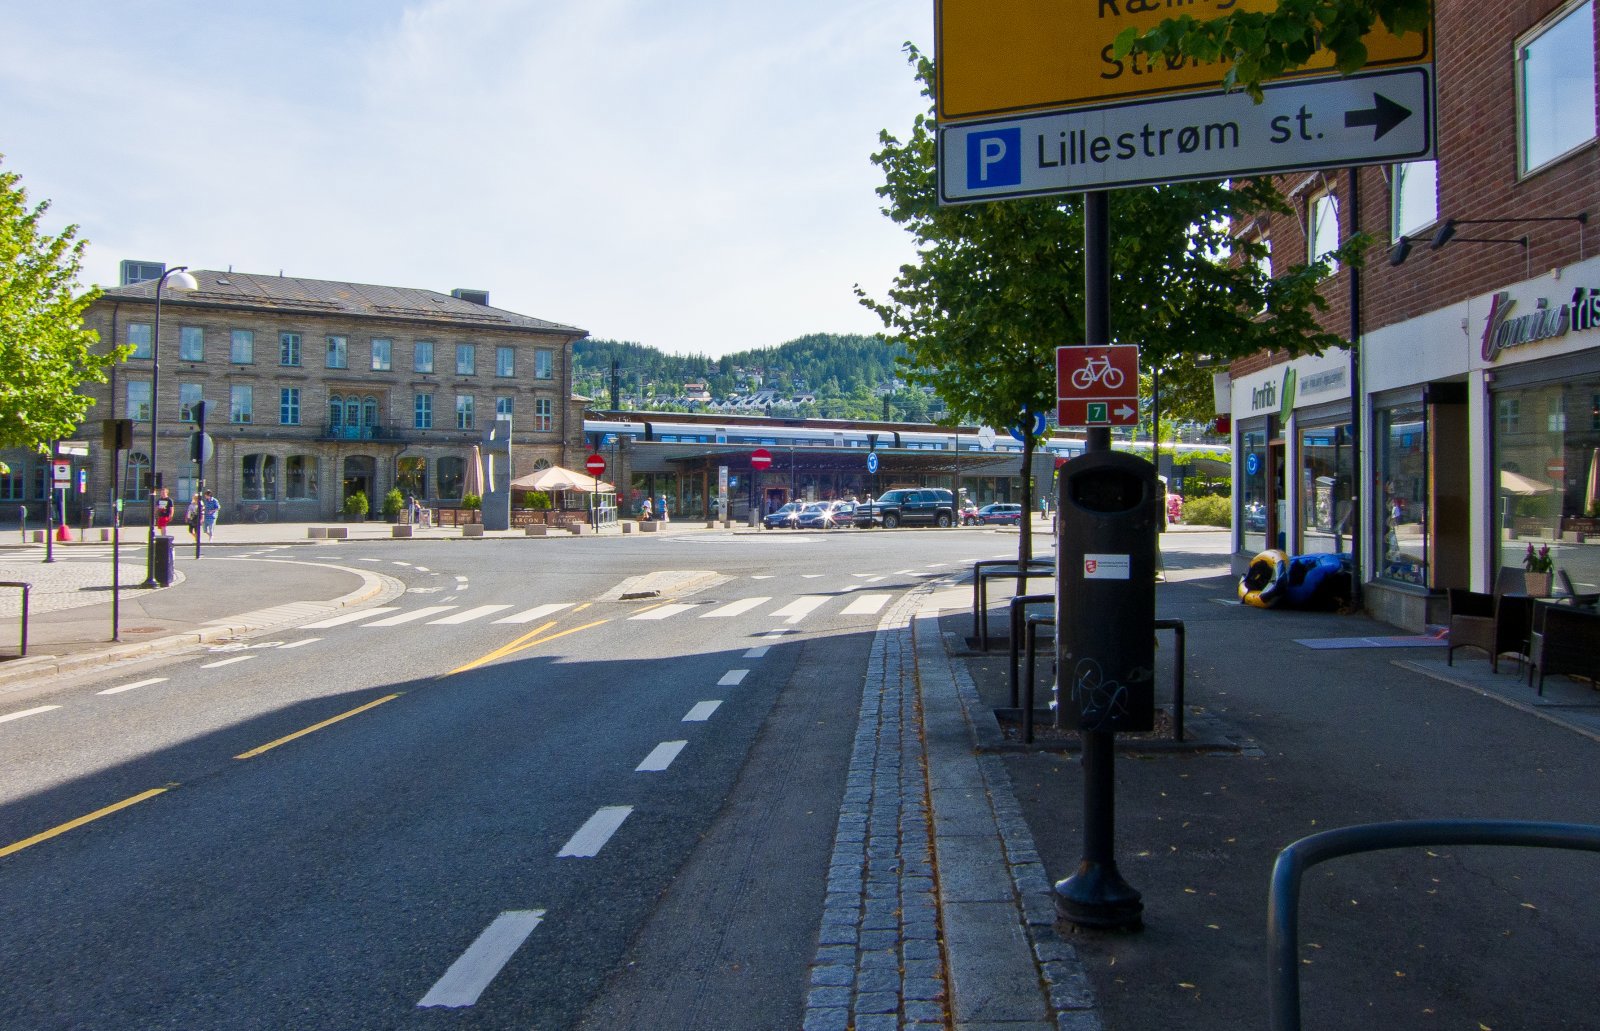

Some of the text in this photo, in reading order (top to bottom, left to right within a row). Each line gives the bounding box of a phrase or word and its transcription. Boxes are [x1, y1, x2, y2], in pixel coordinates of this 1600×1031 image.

[980, 105, 1325, 181] P Lillestrøm st.
[1093, 406, 1102, 419] 7
